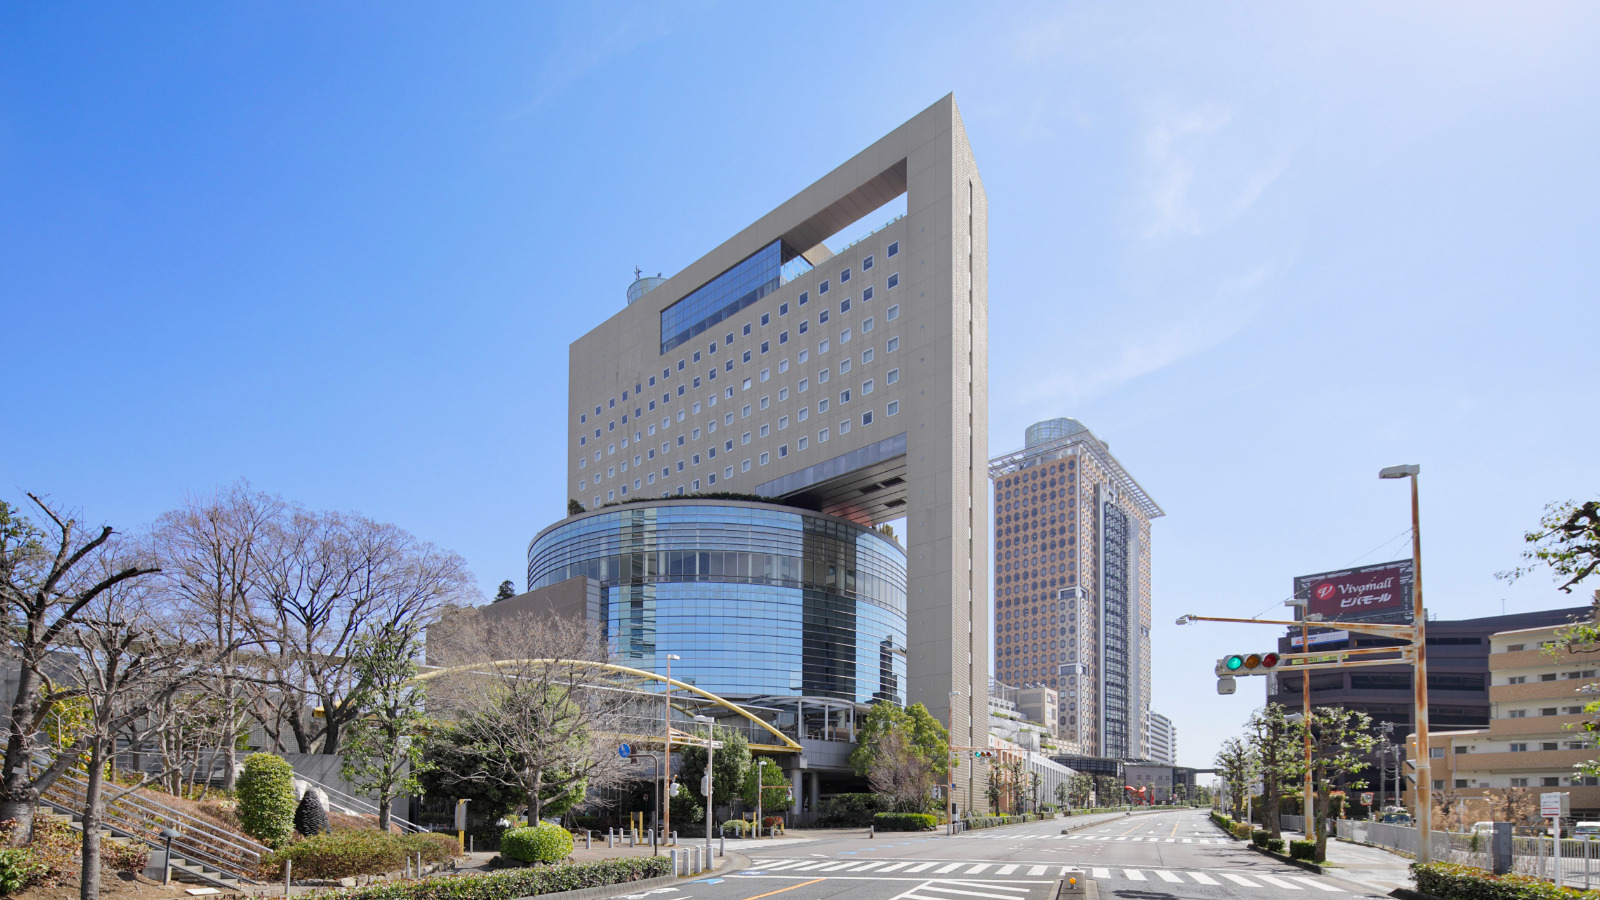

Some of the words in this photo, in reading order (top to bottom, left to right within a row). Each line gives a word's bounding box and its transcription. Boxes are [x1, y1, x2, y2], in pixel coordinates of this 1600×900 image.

[1338, 577, 1394, 594] Vivamall
[1340, 593, 1392, 607] ビバモール
